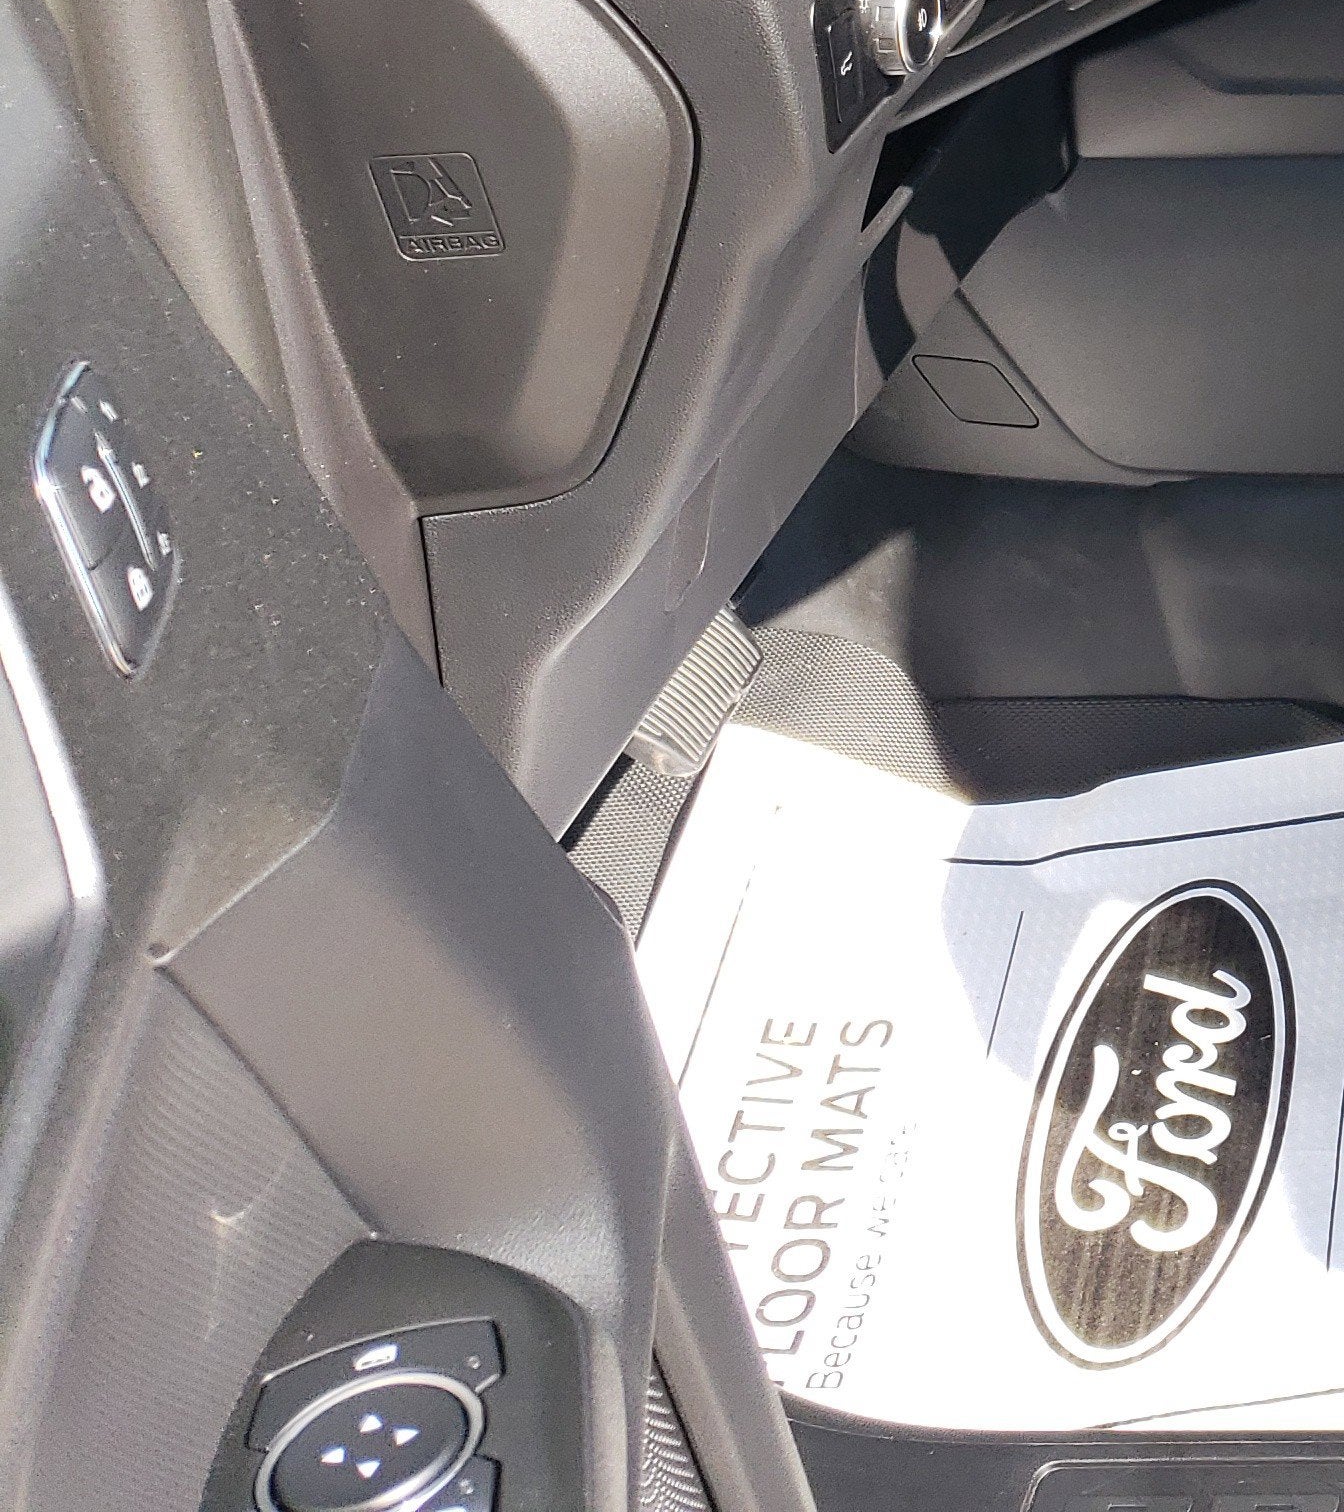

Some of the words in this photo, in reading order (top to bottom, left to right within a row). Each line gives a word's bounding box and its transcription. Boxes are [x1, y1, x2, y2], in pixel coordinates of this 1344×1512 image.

[406, 235, 499, 253] AIRBAG
[755, 1194, 846, 1386] LOOR
[801, 1019, 894, 1171] MATS
[1055, 969, 1252, 1252] Ford
[805, 1254, 882, 1389] Because
